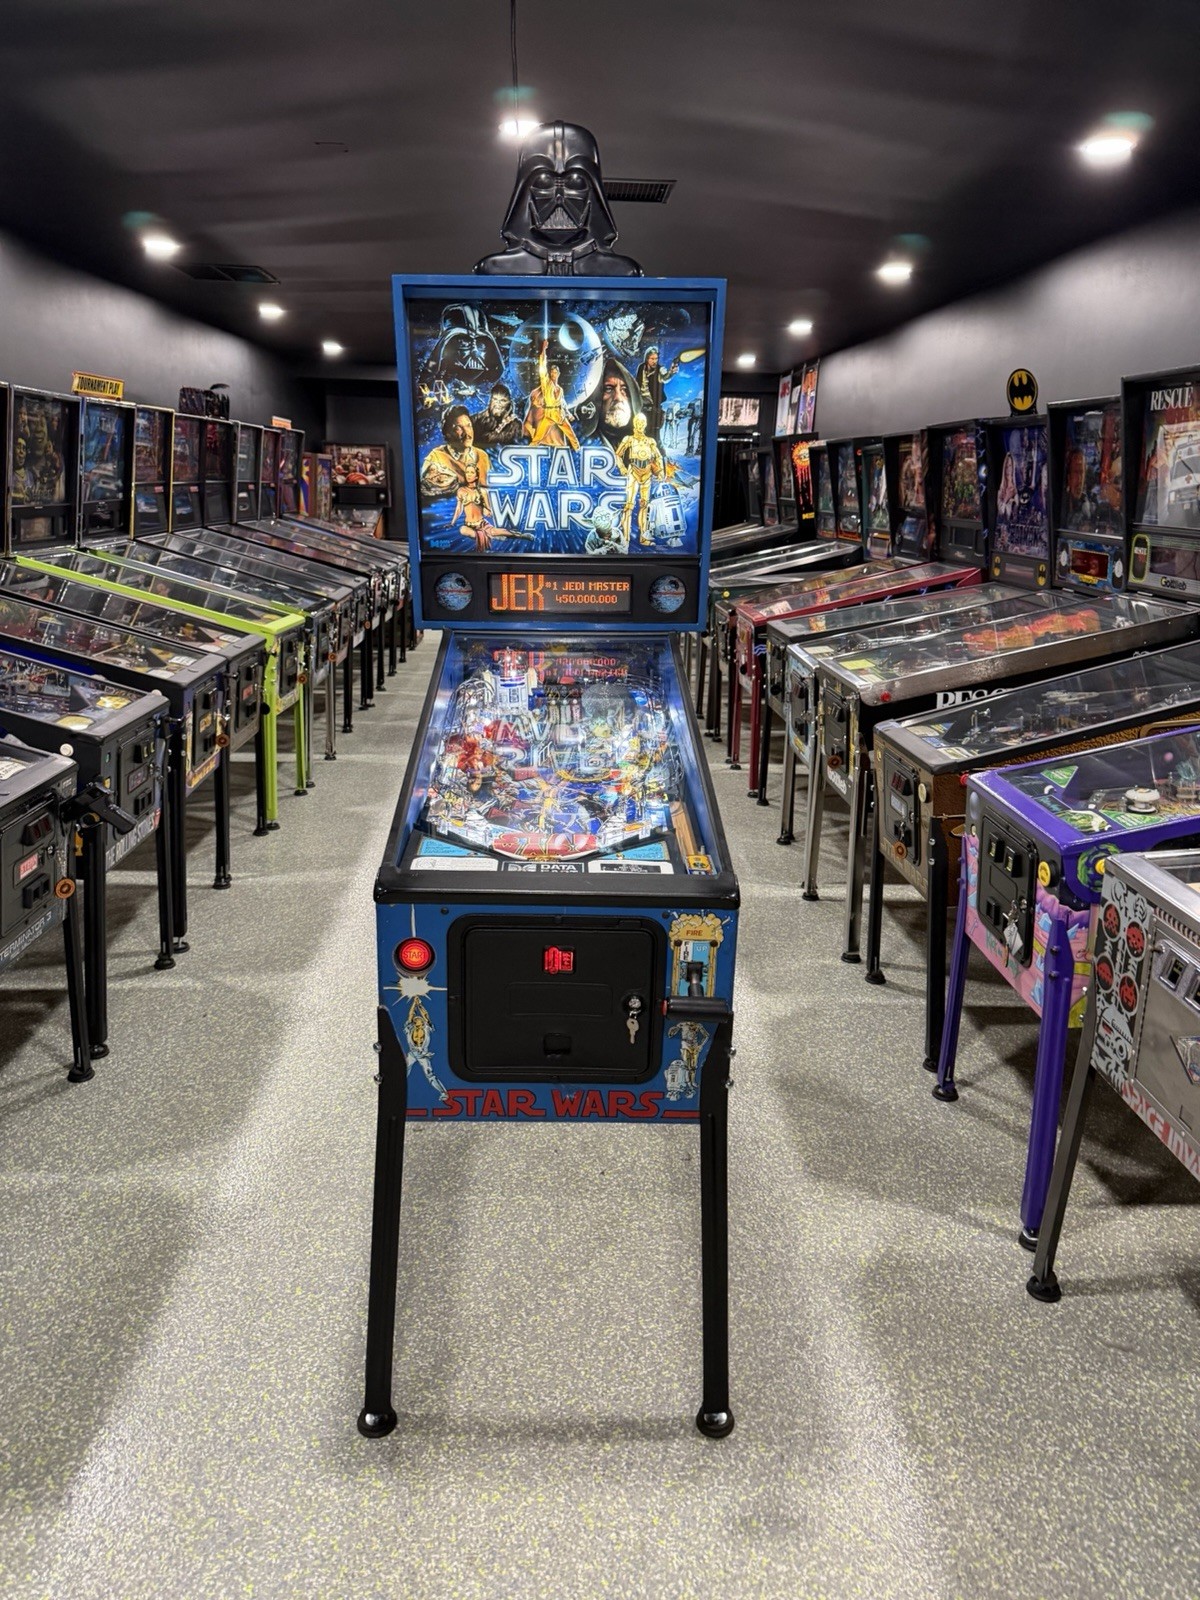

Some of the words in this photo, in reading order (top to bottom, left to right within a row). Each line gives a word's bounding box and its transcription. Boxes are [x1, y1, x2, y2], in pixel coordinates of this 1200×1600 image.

[77, 376, 108, 394] TOURNAMENT
[108, 381, 120, 395] PLAY
[1150, 386, 1194, 411] RESCUE
[487, 445, 628, 487] STAR
[488, 489, 628, 531] WARS
[491, 574, 545, 611] JEK
[562, 581, 585, 591] JEDI
[588, 581, 630, 592] MASTER
[540, 863, 577, 871] DATA
[0, 916, 45, 961] TERMINATOR
[686, 929, 703, 937] FIRE
[403, 950, 428, 960] START
[432, 1088, 546, 1118] STAR
[551, 1088, 666, 1118] WARS
[1121, 1080, 1165, 1141] SPACE
